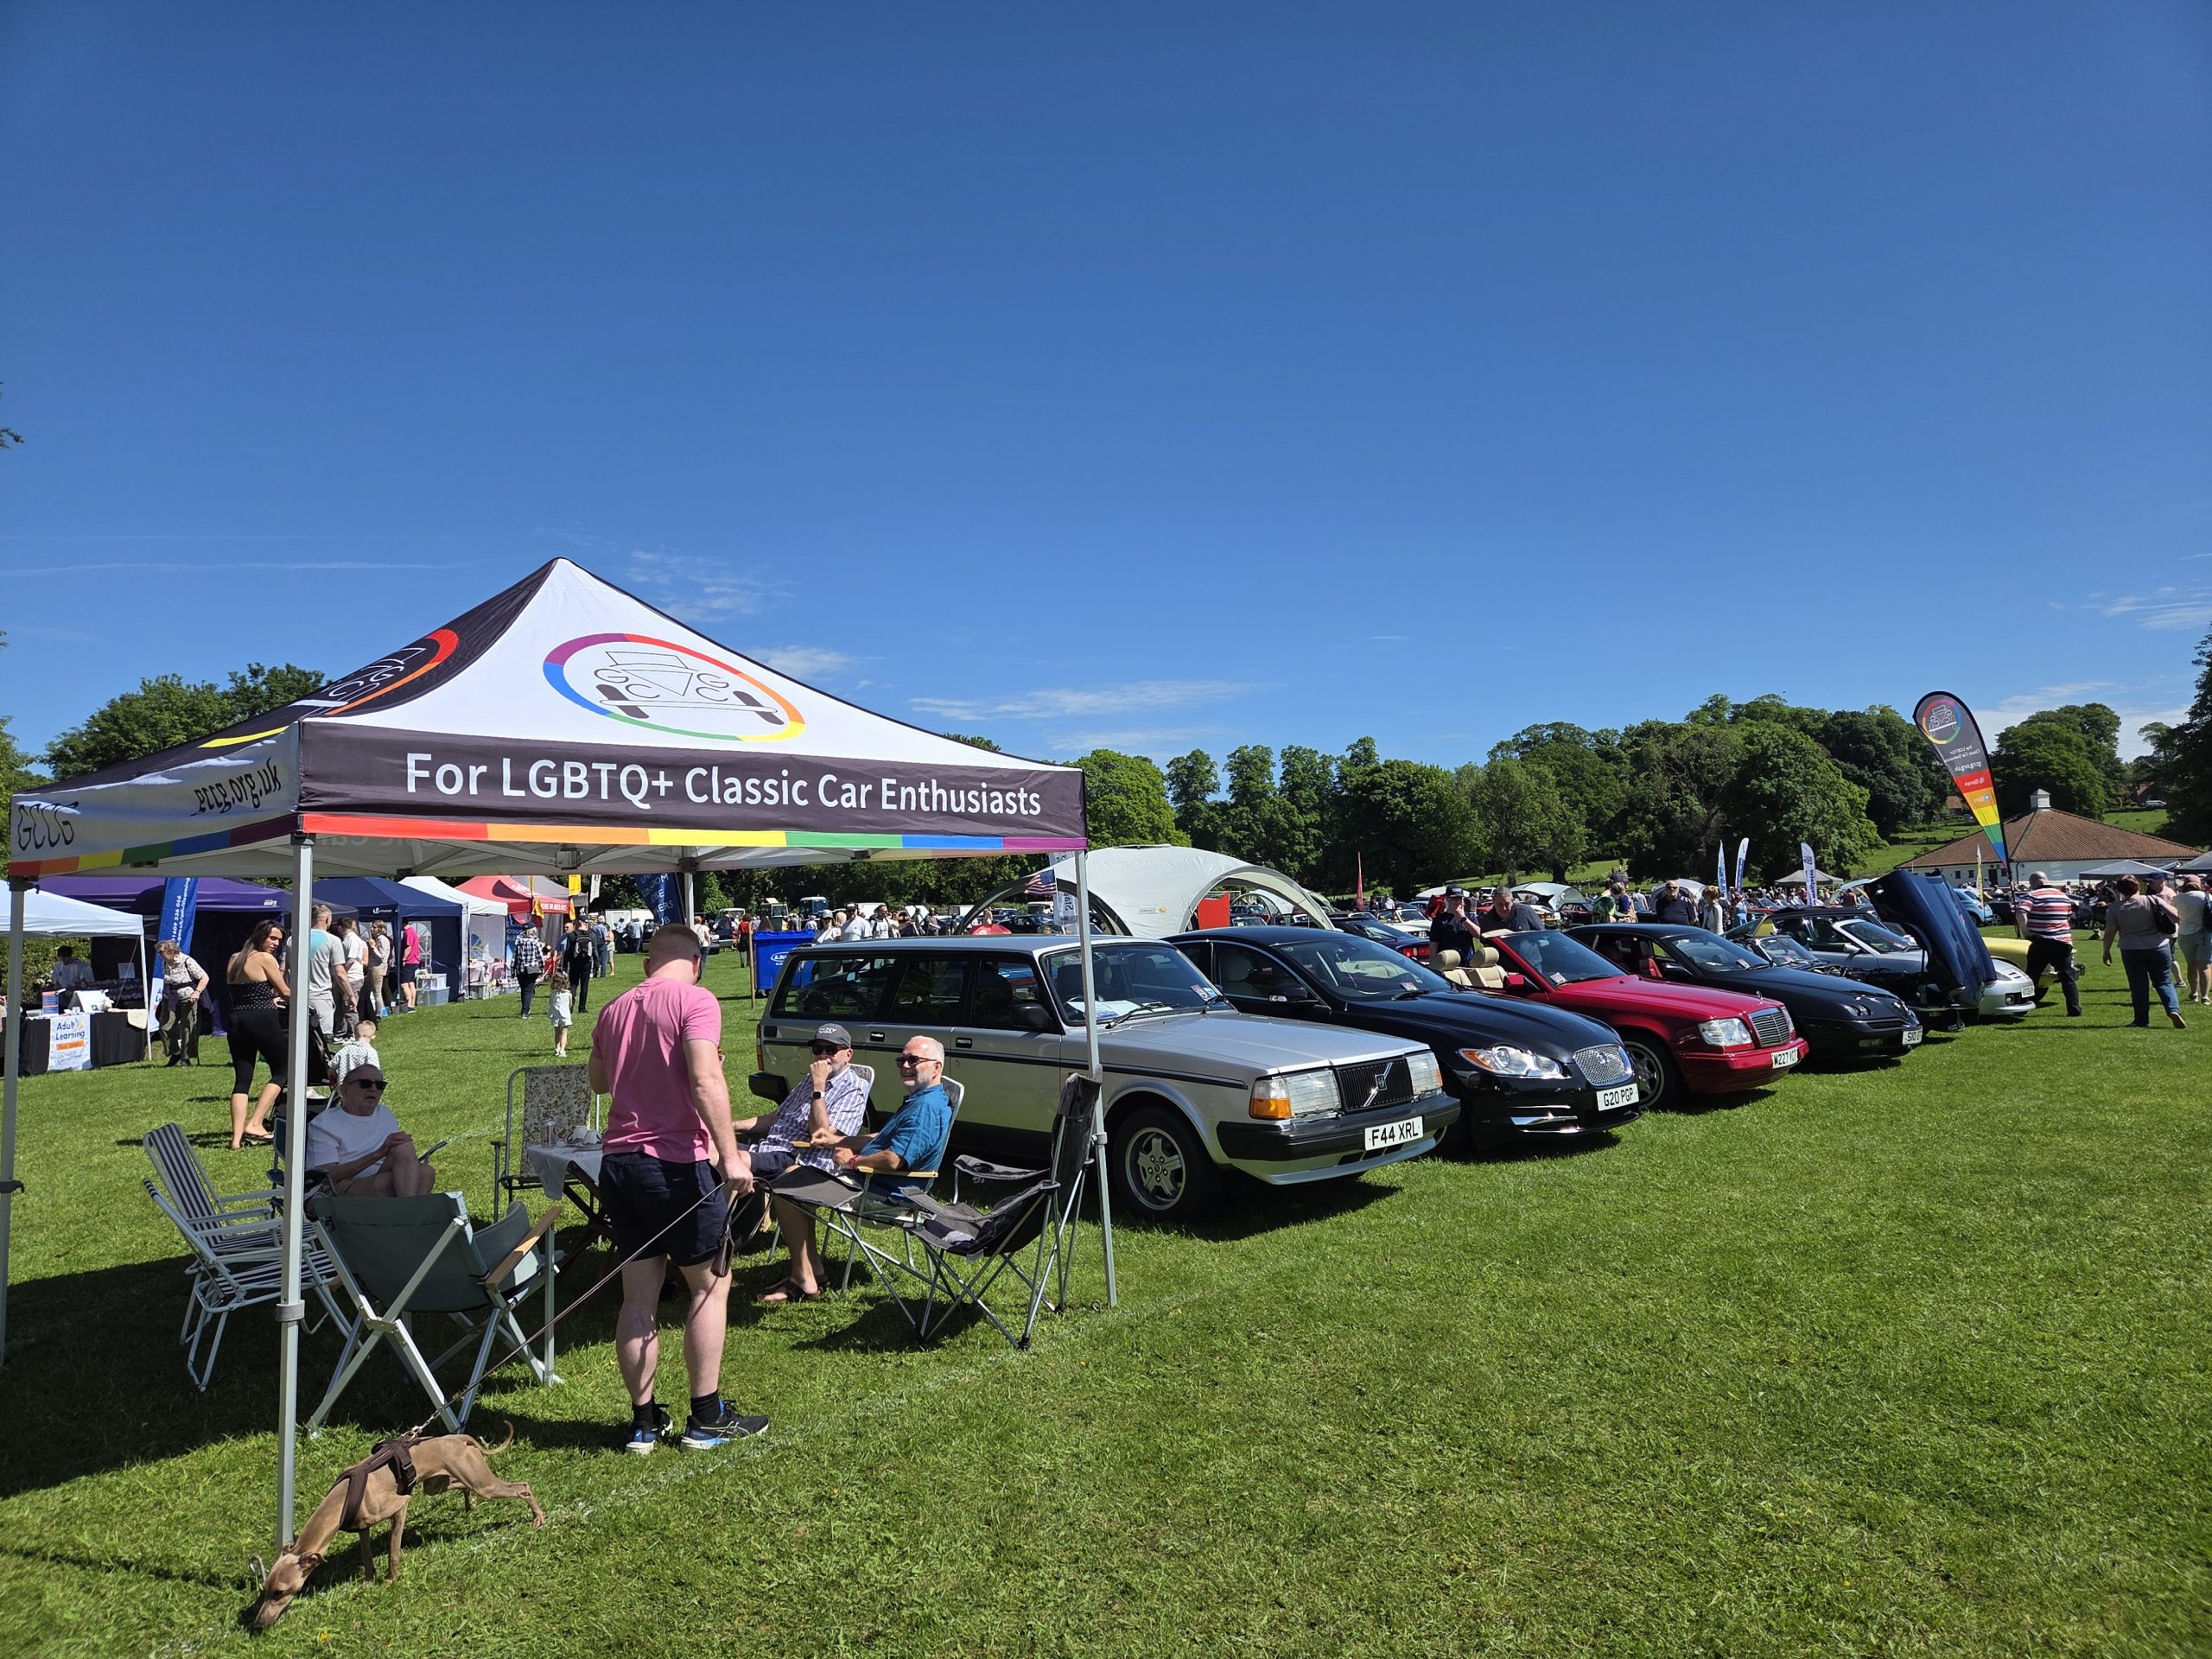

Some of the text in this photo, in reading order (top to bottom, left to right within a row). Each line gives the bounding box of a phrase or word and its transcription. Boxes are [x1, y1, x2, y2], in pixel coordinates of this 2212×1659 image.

[407, 753, 1042, 816] For LGBTQ+ Classic Car Enthusiasts
[17, 801, 79, 851] GCCG
[55, 1031, 85, 1040] Learning
[1603, 1087, 1634, 1107] G20 PGP
[1372, 1121, 1419, 1147] F44 XRL
